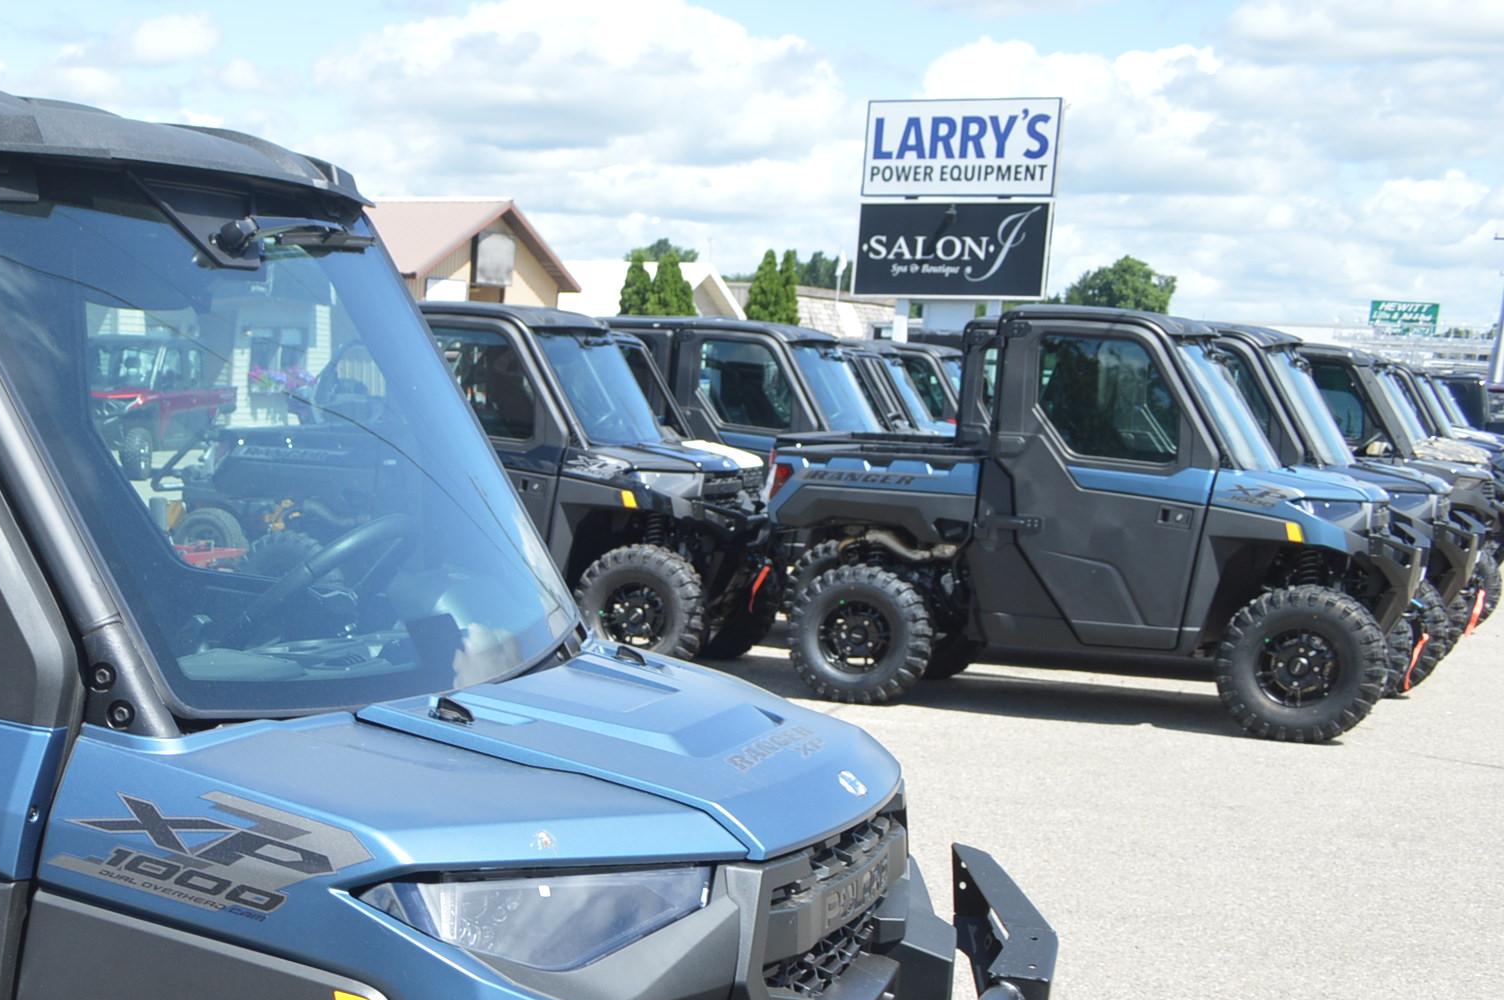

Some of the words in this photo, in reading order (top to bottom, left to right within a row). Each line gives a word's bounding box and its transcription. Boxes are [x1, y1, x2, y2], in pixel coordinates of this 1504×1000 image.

[872, 108, 1052, 160] LARRY'S
[870, 165, 933, 182] POWER
[940, 164, 1048, 182] EQUIPMENT
[868, 235, 990, 260] SALON
[890, 263, 907, 276] Spa
[921, 264, 960, 277] Boutique
[1378, 302, 1432, 312] HEWITT
[805, 470, 917, 486] RANGER
[1224, 483, 1288, 500] XP
[725, 725, 815, 771] RANGER
[795, 737, 825, 760] XP
[63, 791, 337, 876] XP
[104, 846, 288, 913] 1000
[98, 869, 137, 886] DUAL
[141, 881, 227, 910] OVERHEAD
[228, 907, 268, 922] CAM
